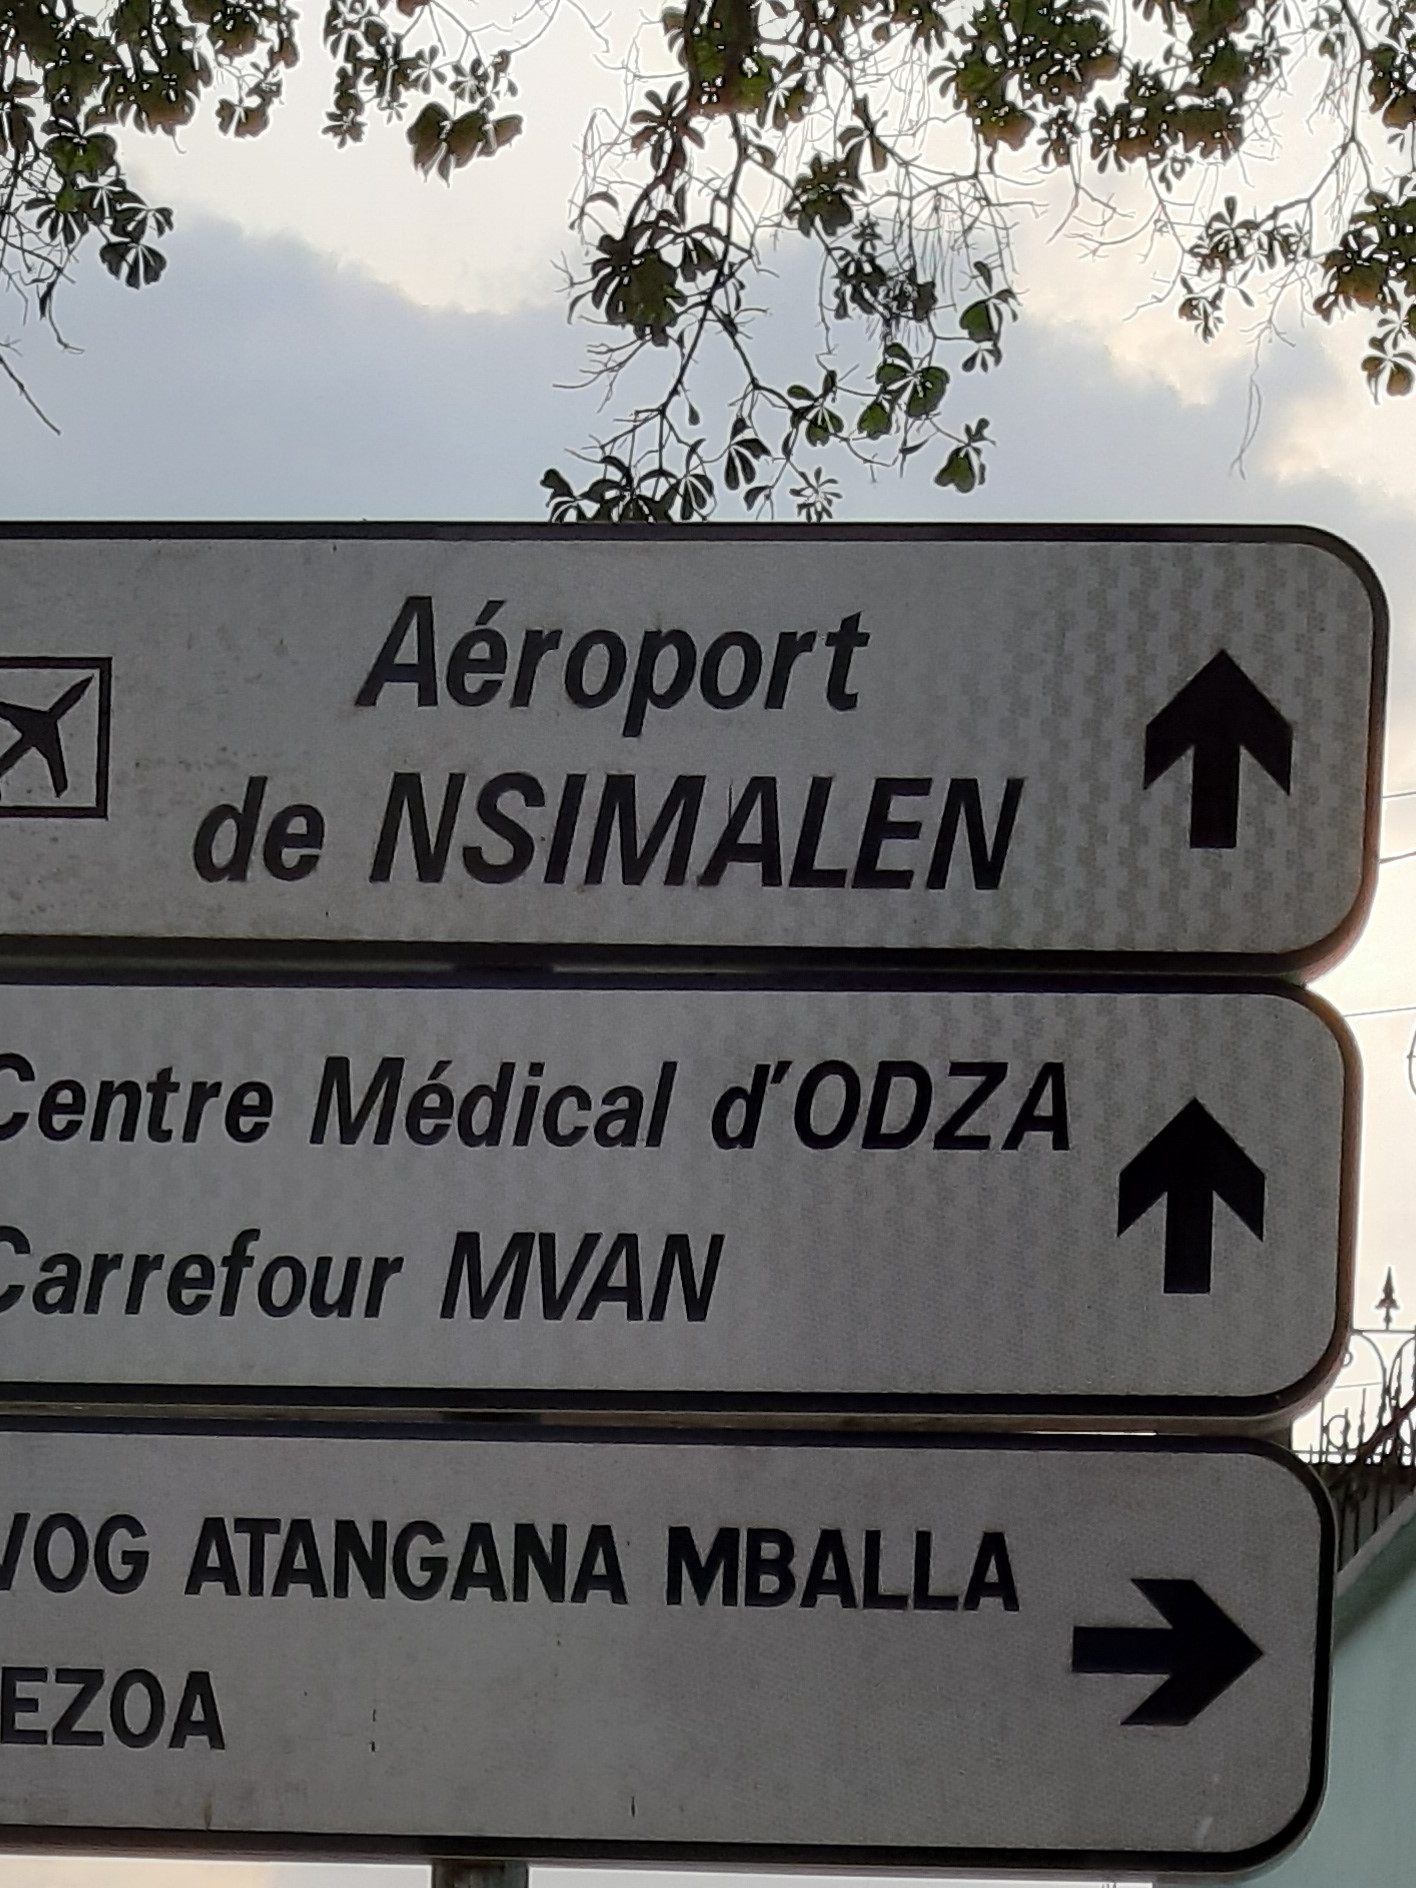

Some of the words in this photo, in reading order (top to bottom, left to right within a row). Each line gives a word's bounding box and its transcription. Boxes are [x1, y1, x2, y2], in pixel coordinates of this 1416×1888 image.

[352, 593, 872, 740] Aéroport
[191, 774, 326, 884] de
[367, 770, 1027, 892] NSIMALEN
[308, 1054, 679, 1149] Médical
[710, 1058, 1071, 1152] d'ODZA
[439, 1229, 726, 1323] MVAN
[183, 1515, 629, 1606] ATANGANA
[665, 1525, 1021, 1613] MBALLA
